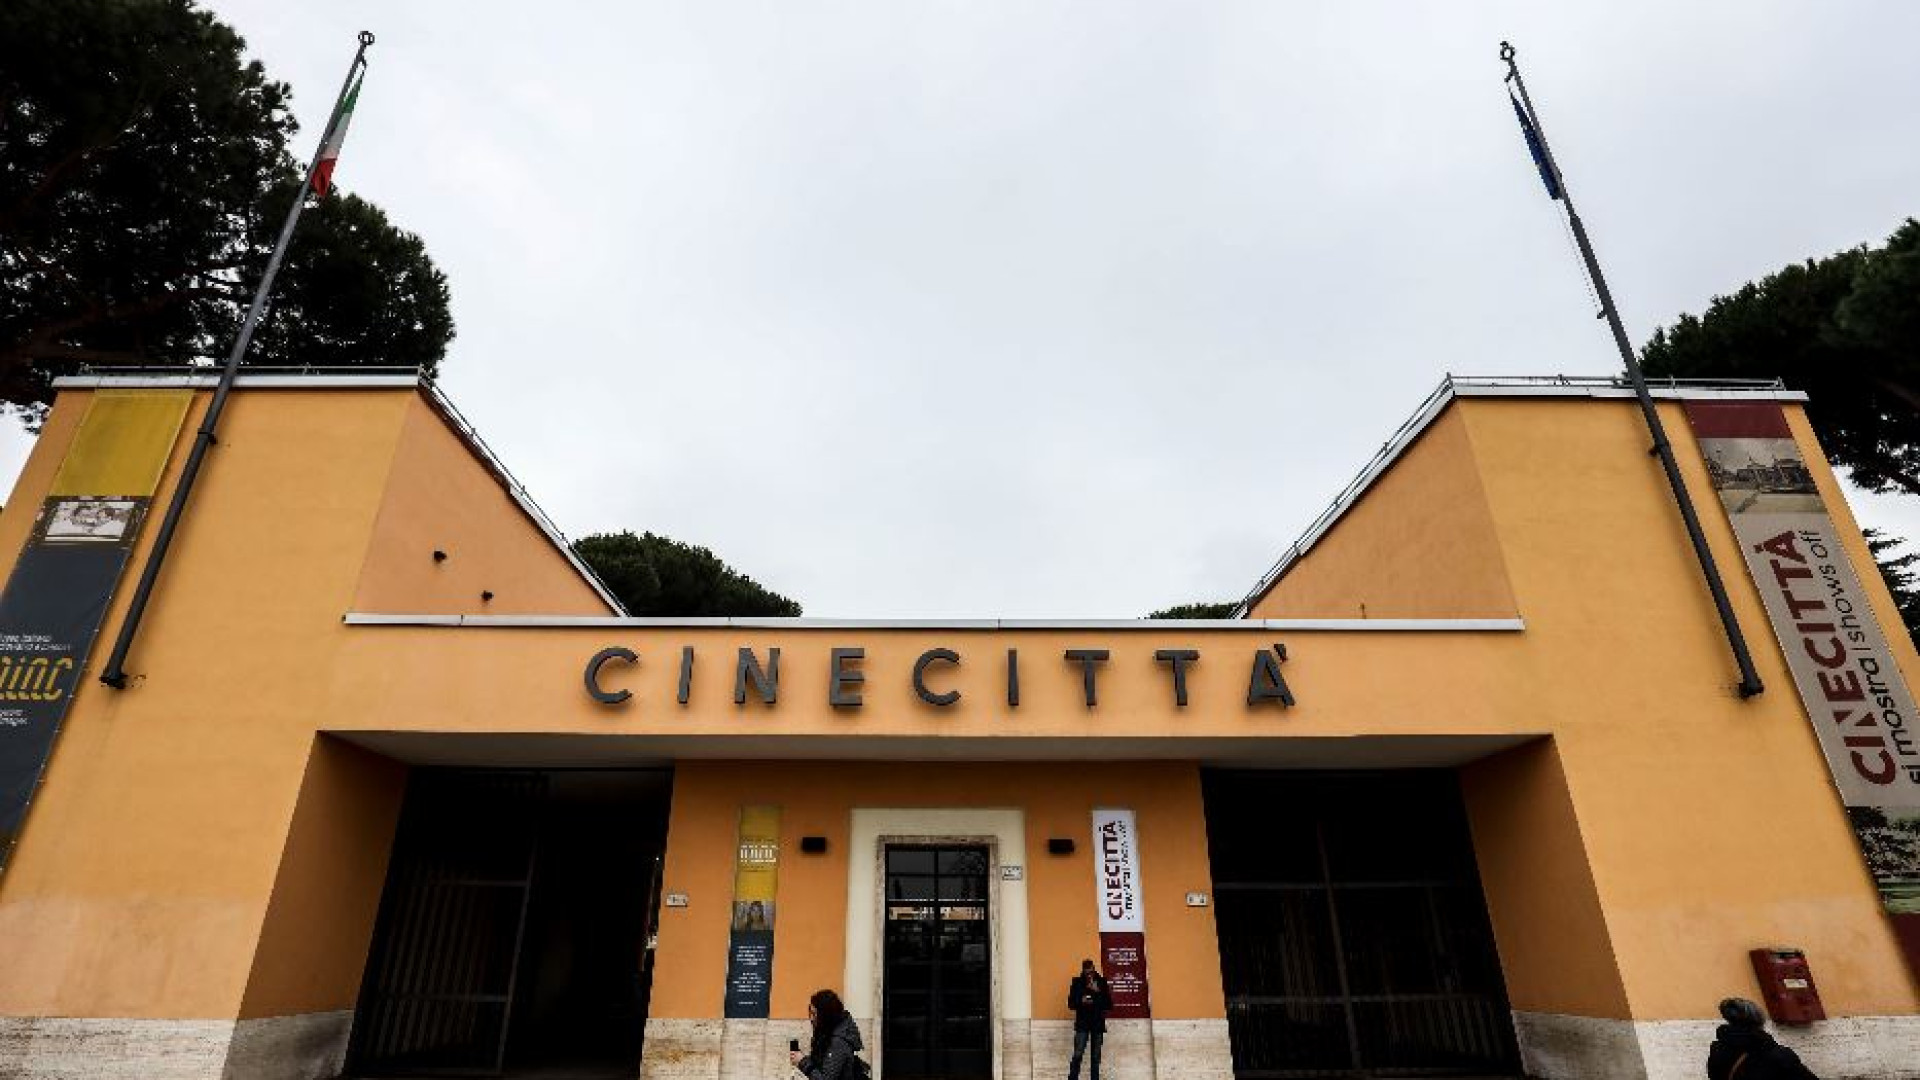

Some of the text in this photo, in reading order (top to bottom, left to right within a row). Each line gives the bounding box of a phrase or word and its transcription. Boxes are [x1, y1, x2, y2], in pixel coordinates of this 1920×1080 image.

[1799, 530, 1828, 559] off
[1819, 564, 1865, 643] shows
[583, 643, 1296, 707] CINECITTÀ
[1753, 530, 1896, 785] CINECITTÀ
[1858, 657, 1918, 755] mostra
[1099, 821, 1124, 920] CINECITTÀ
